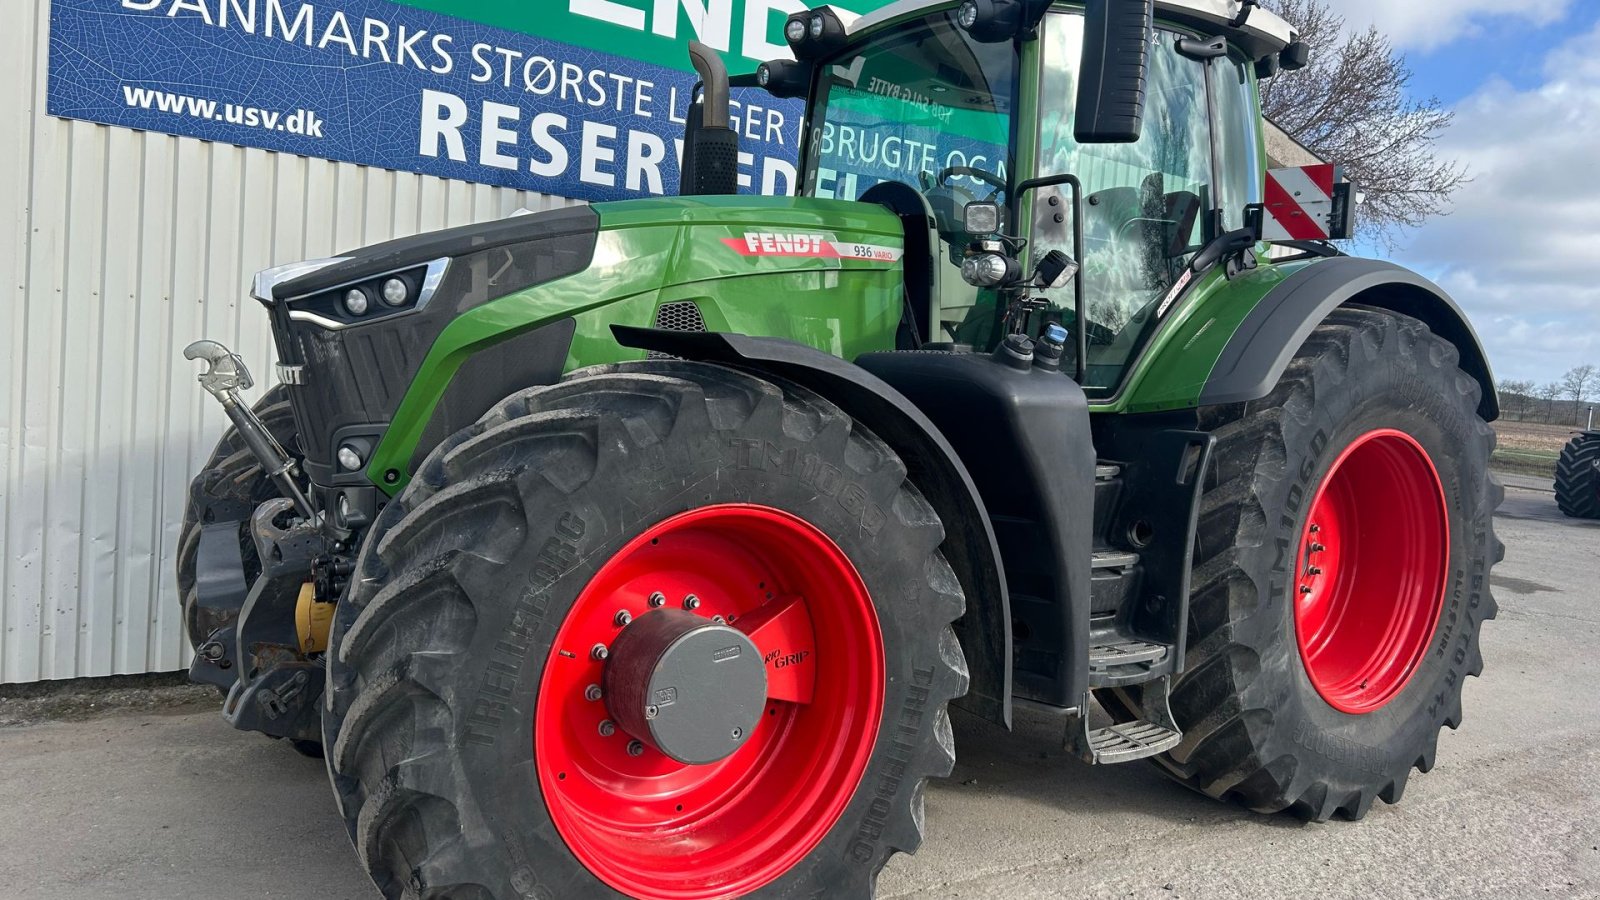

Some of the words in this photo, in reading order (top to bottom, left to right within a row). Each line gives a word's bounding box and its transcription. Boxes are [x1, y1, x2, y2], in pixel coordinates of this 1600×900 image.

[123, 85, 323, 138] www.usv.dk
[471, 43, 654, 118] STØRSTE
[820, 121, 937, 175] BRUGTE
[744, 232, 824, 254] FENDT
[854, 245, 872, 257] 936
[874, 250, 893, 260] VARIO
[774, 650, 810, 669] GRIP
